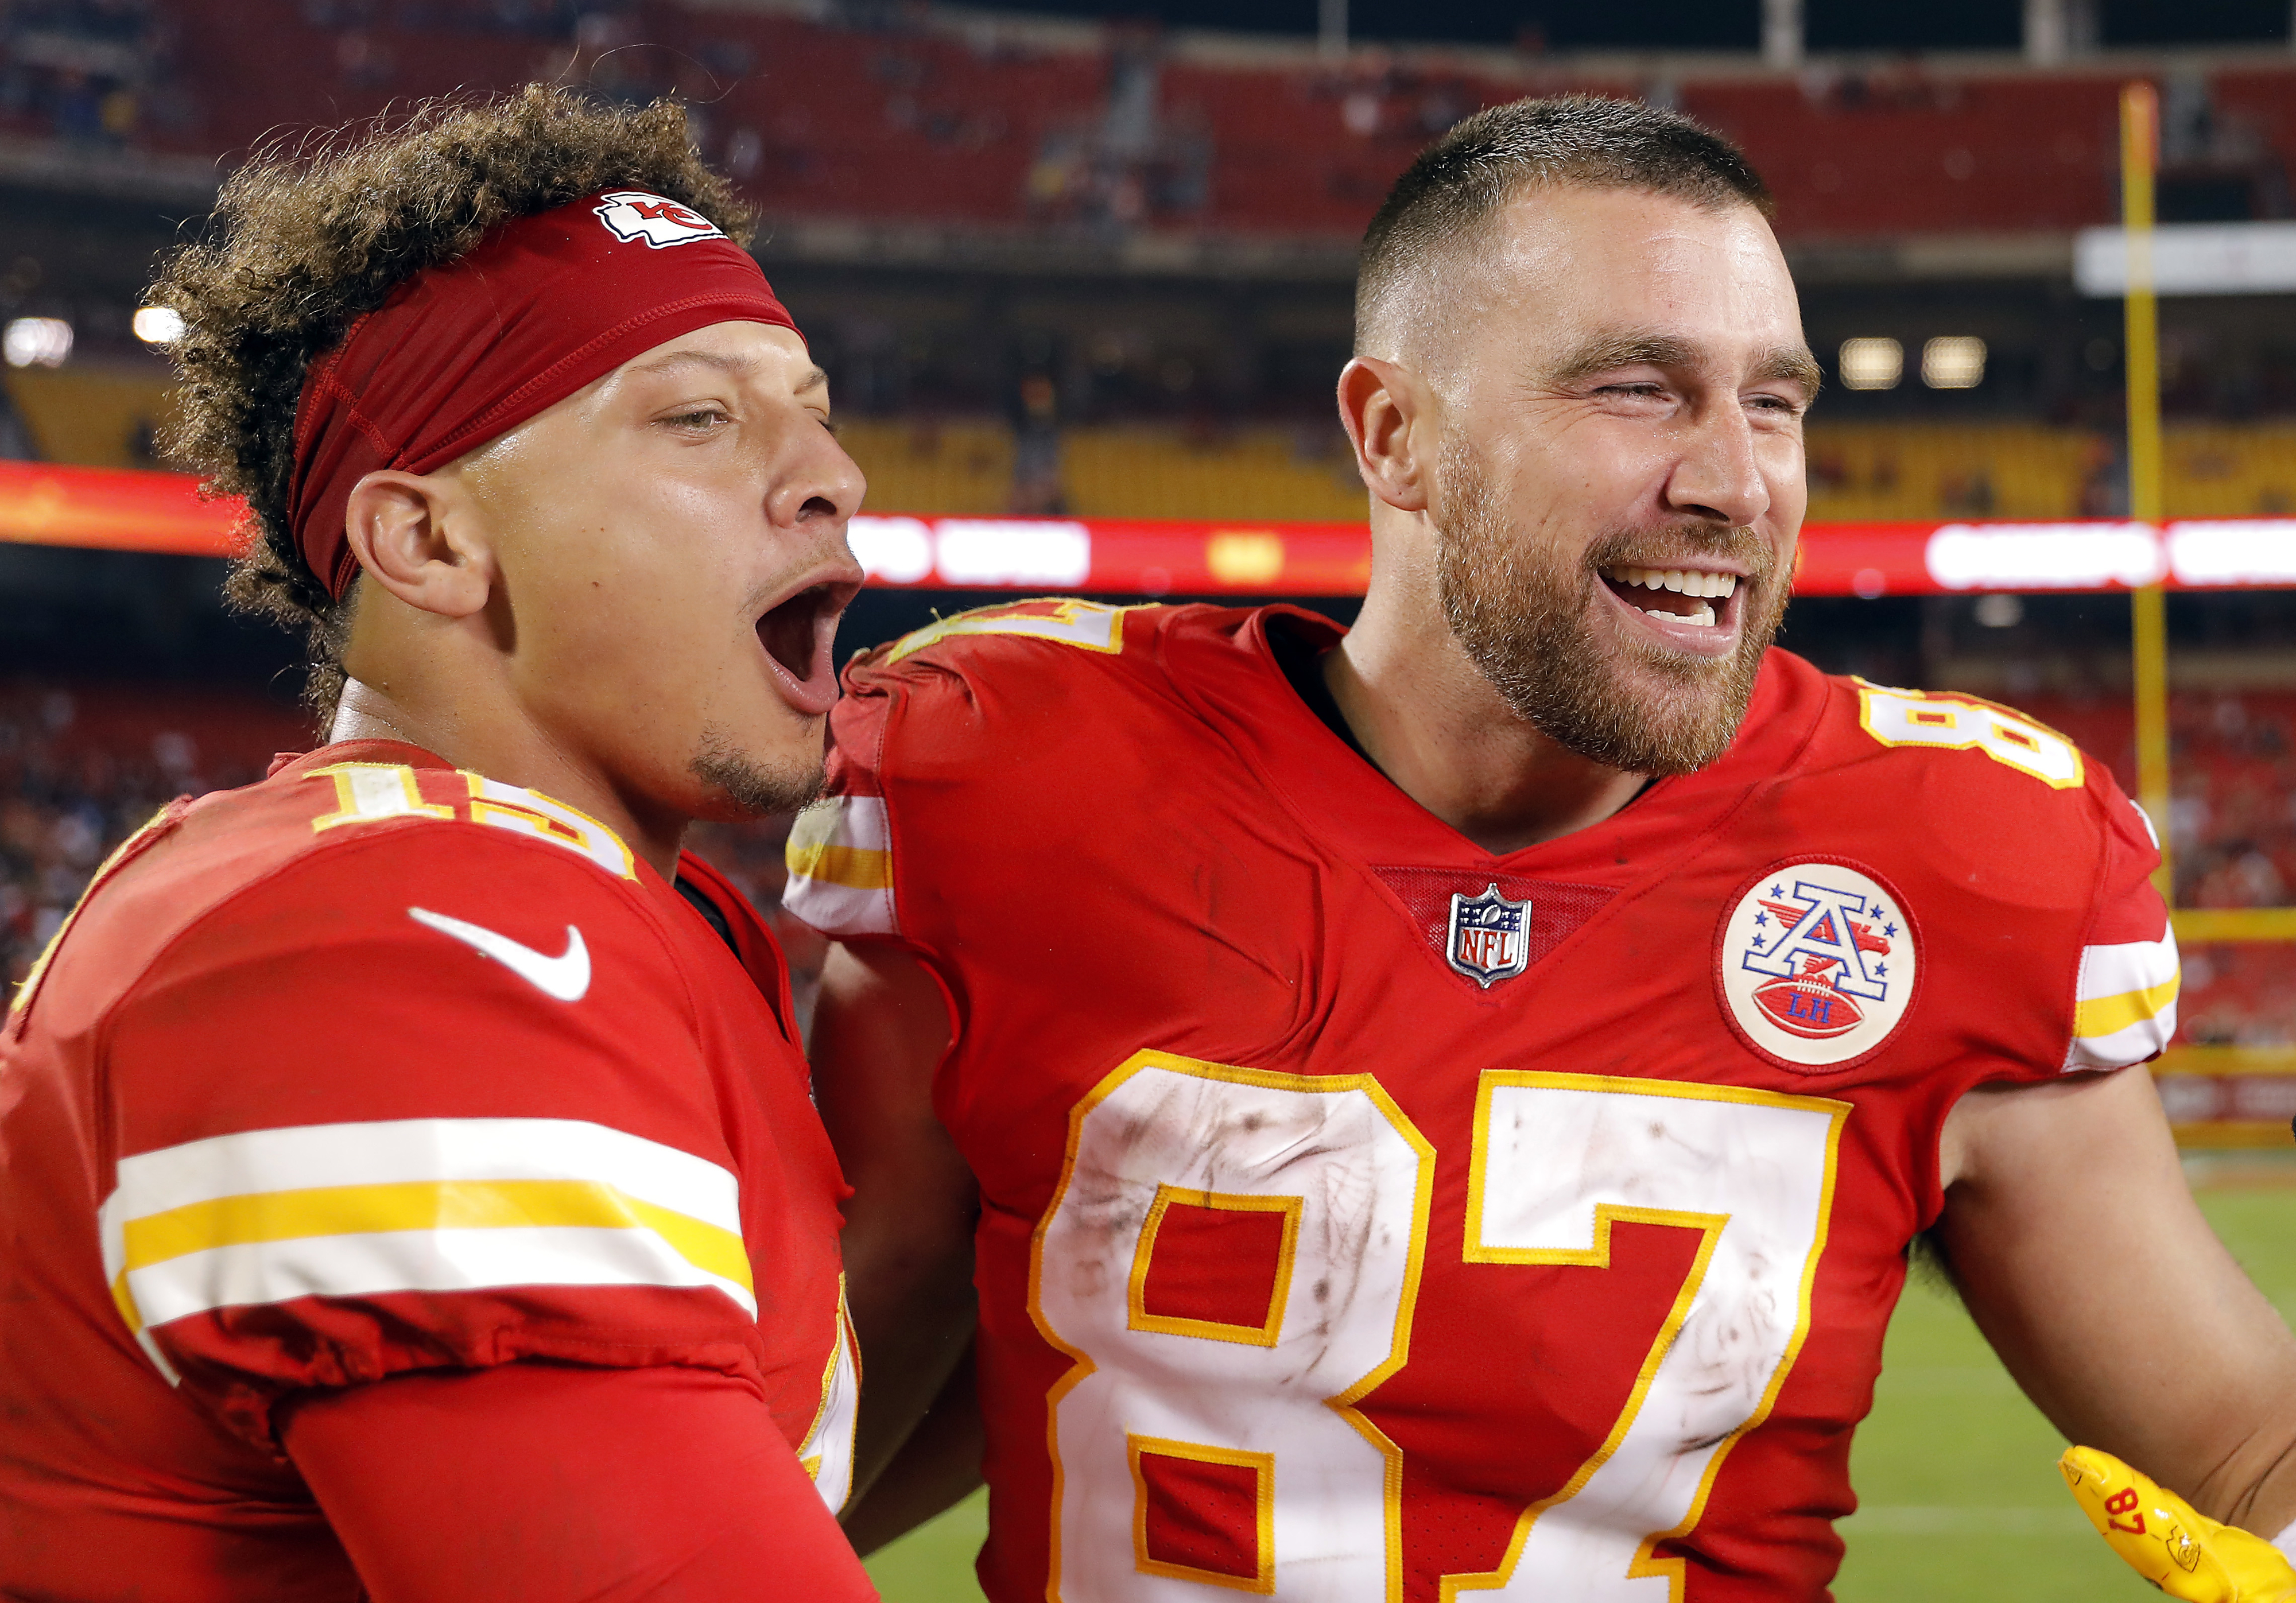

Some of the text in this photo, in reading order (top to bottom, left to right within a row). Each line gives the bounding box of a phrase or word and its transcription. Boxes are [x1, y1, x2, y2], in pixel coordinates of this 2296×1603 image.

[1461, 929, 1512, 969] NFL
[1786, 992, 1833, 1023] LH
[1026, 1047, 1854, 1602] 87
[2104, 1486, 2146, 1535] 87
